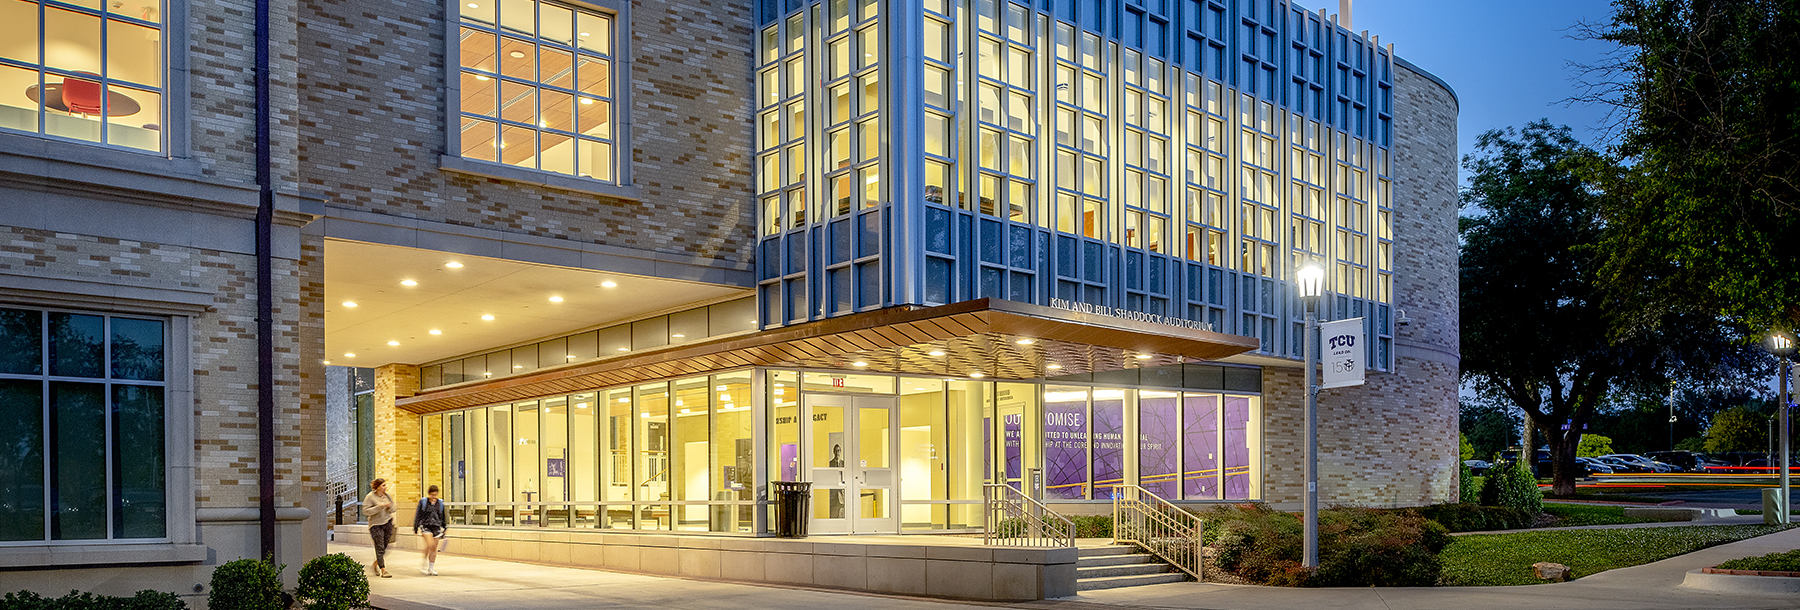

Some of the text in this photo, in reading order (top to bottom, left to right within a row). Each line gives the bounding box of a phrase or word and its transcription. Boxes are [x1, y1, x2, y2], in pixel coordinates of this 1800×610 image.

[1050, 297, 1213, 332] KIM AND BILL SHADDOCK AUDITORIUM
[1329, 335, 1355, 350] TCU
[1005, 412, 1080, 427] OU OMISE
[1006, 430, 1014, 438] WE
[1045, 431, 1060, 439] ITTED
